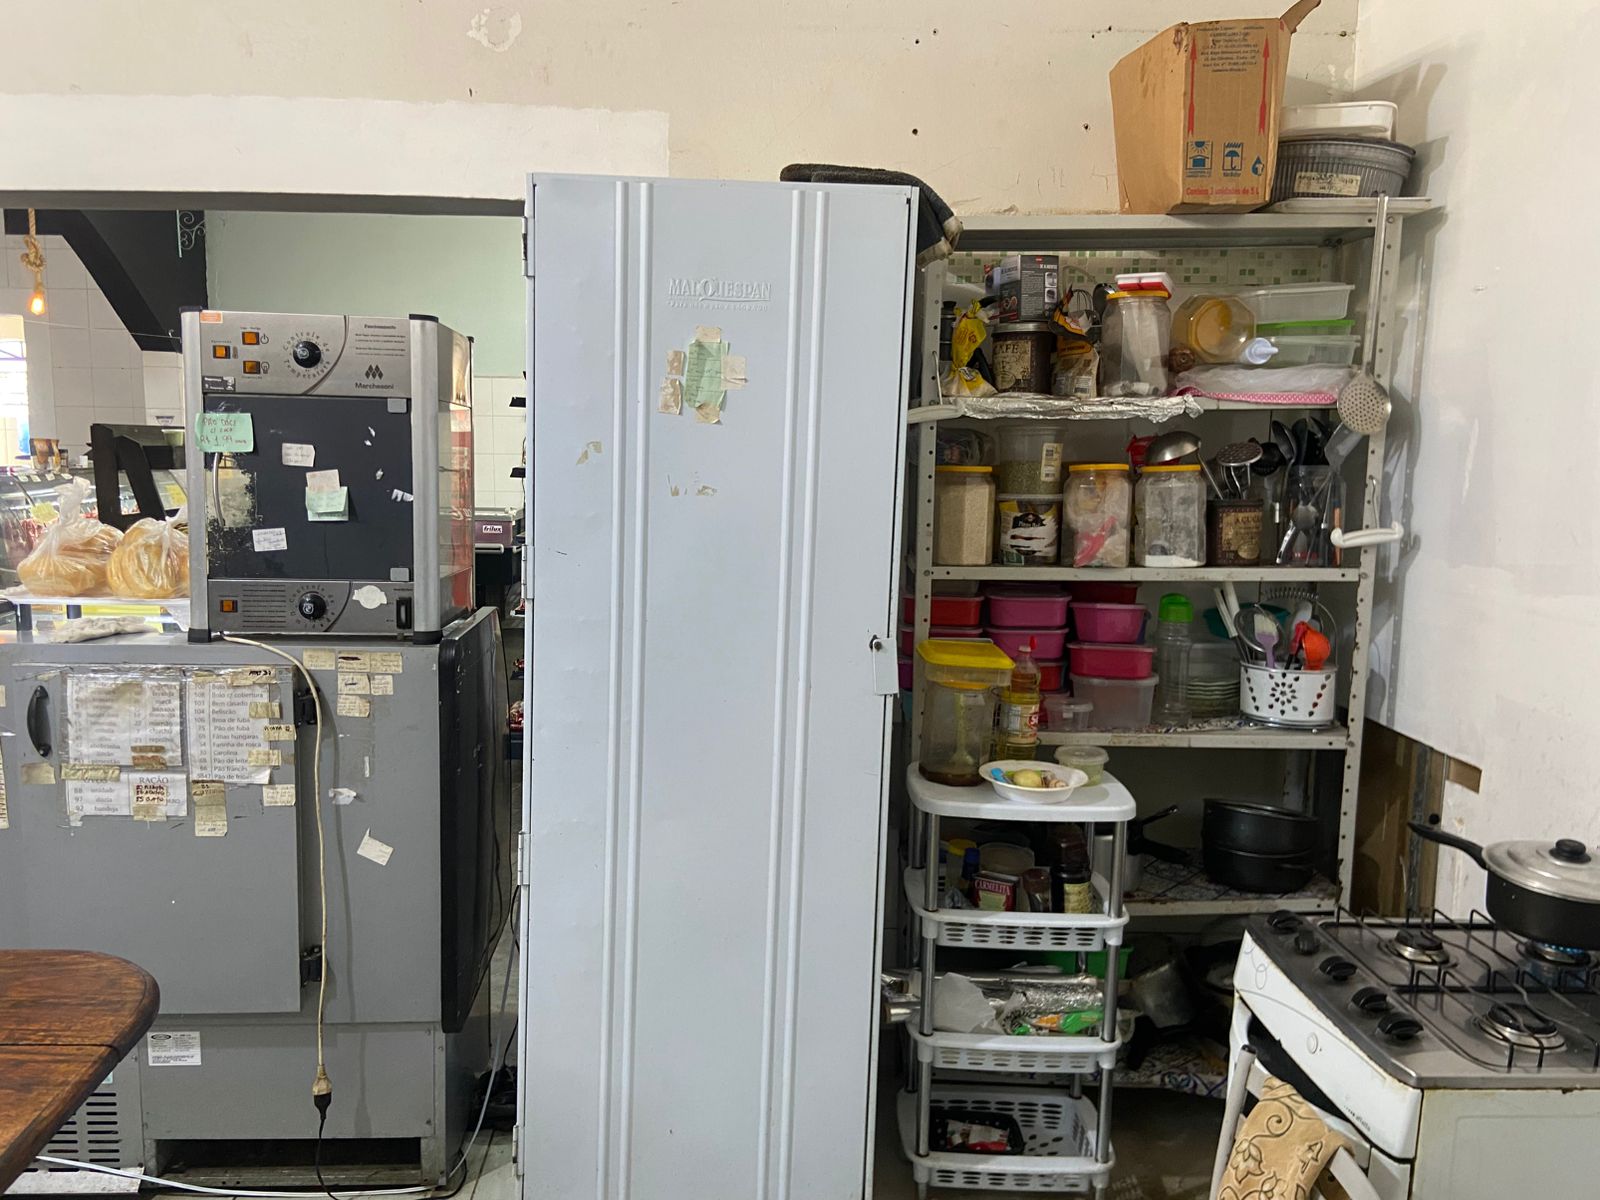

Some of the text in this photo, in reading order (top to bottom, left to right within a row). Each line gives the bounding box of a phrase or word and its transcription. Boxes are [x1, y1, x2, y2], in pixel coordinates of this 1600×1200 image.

[354, 381, 395, 390] Marchesoni
[139, 774, 169, 784] RAÇÃO
[974, 880, 1011, 896] CARMELITA
